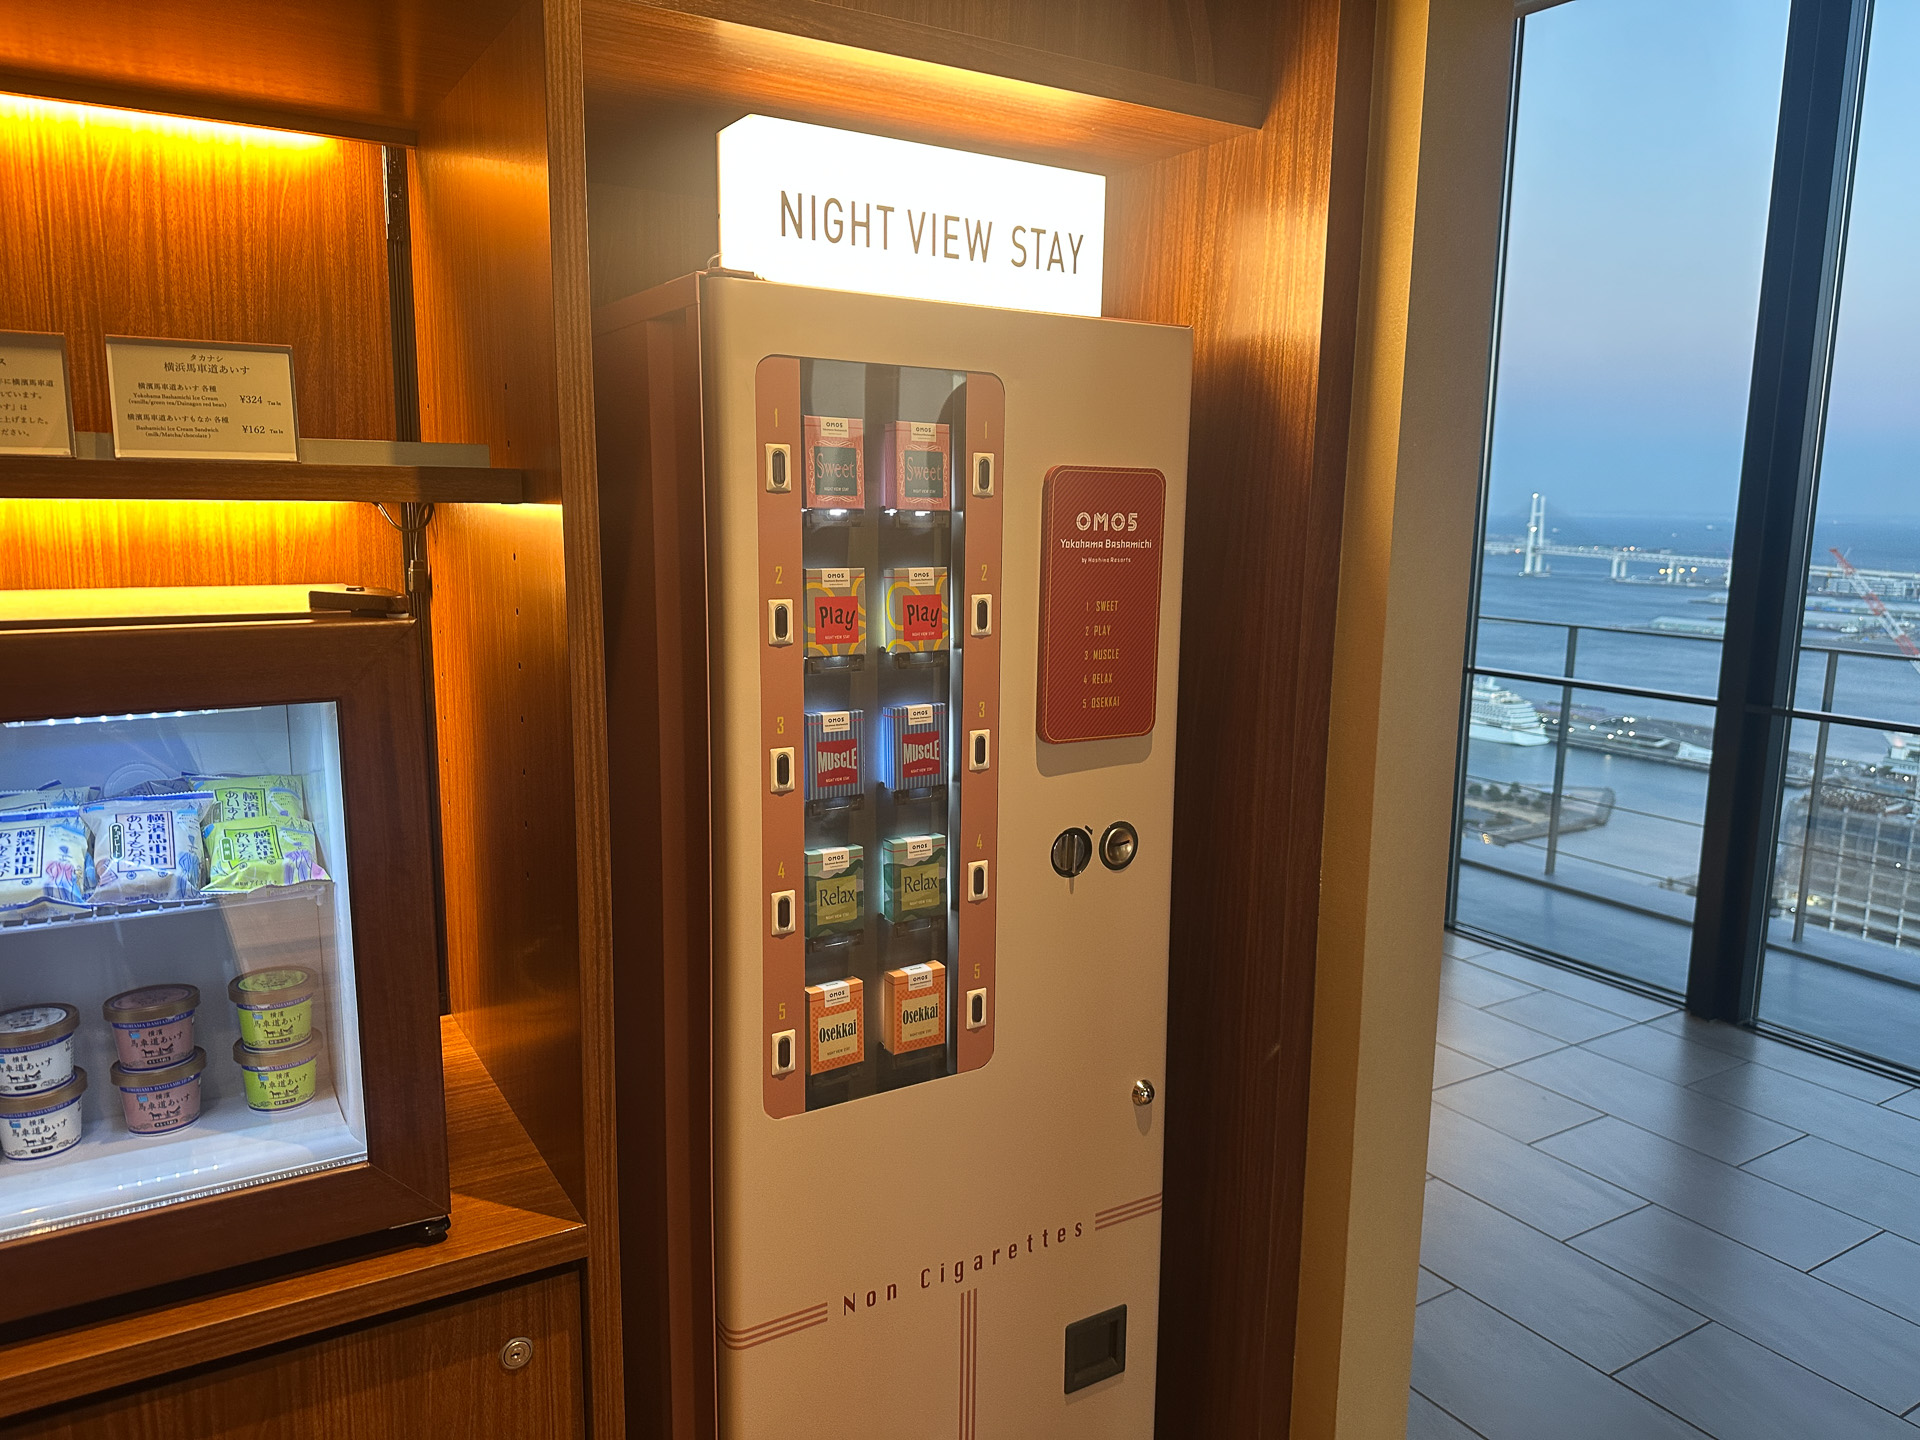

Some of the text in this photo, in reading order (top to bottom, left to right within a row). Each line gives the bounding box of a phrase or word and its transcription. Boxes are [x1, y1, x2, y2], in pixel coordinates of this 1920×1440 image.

[780, 190, 1084, 274] NIGHT VIEW STAY
[190, 353, 224, 362] タカナシ
[164, 362, 250, 375] 横浜馬車道あいす
[239, 394, 262, 404] ¥324
[0, 416, 48, 424] 上げました。
[242, 425, 265, 434] ¥162
[816, 452, 855, 479] Sweet
[906, 456, 942, 481] Sweet
[1076, 512, 1138, 532] OMO5
[1060, 539, 1152, 549] Yokohama Bashamichi
[775, 566, 783, 584] 2
[981, 564, 988, 582] 2
[1096, 601, 1118, 612] SWEET
[819, 606, 856, 631] Play
[907, 604, 940, 628] Play
[1085, 625, 1111, 636] 2 PLAY
[1085, 649, 1119, 660] 3 MUSCLE
[1092, 673, 1113, 684] RELAX
[978, 701, 985, 718] 3
[1083, 696, 1120, 708] 5 OSEKKAI
[776, 716, 784, 734] 3
[818, 747, 857, 774] MUSCLE
[904, 740, 940, 765] MUSCLE
[976, 834, 983, 849] 4
[777, 861, 785, 878] 4
[904, 873, 938, 893] Relax
[820, 886, 855, 907] Relax
[974, 963, 980, 979] 5
[778, 1002, 786, 1020] 5
[903, 1003, 938, 1025] Osekkai
[819, 1019, 857, 1043] Osekkai
[843, 1222, 1082, 1316] Non Cigarettes
